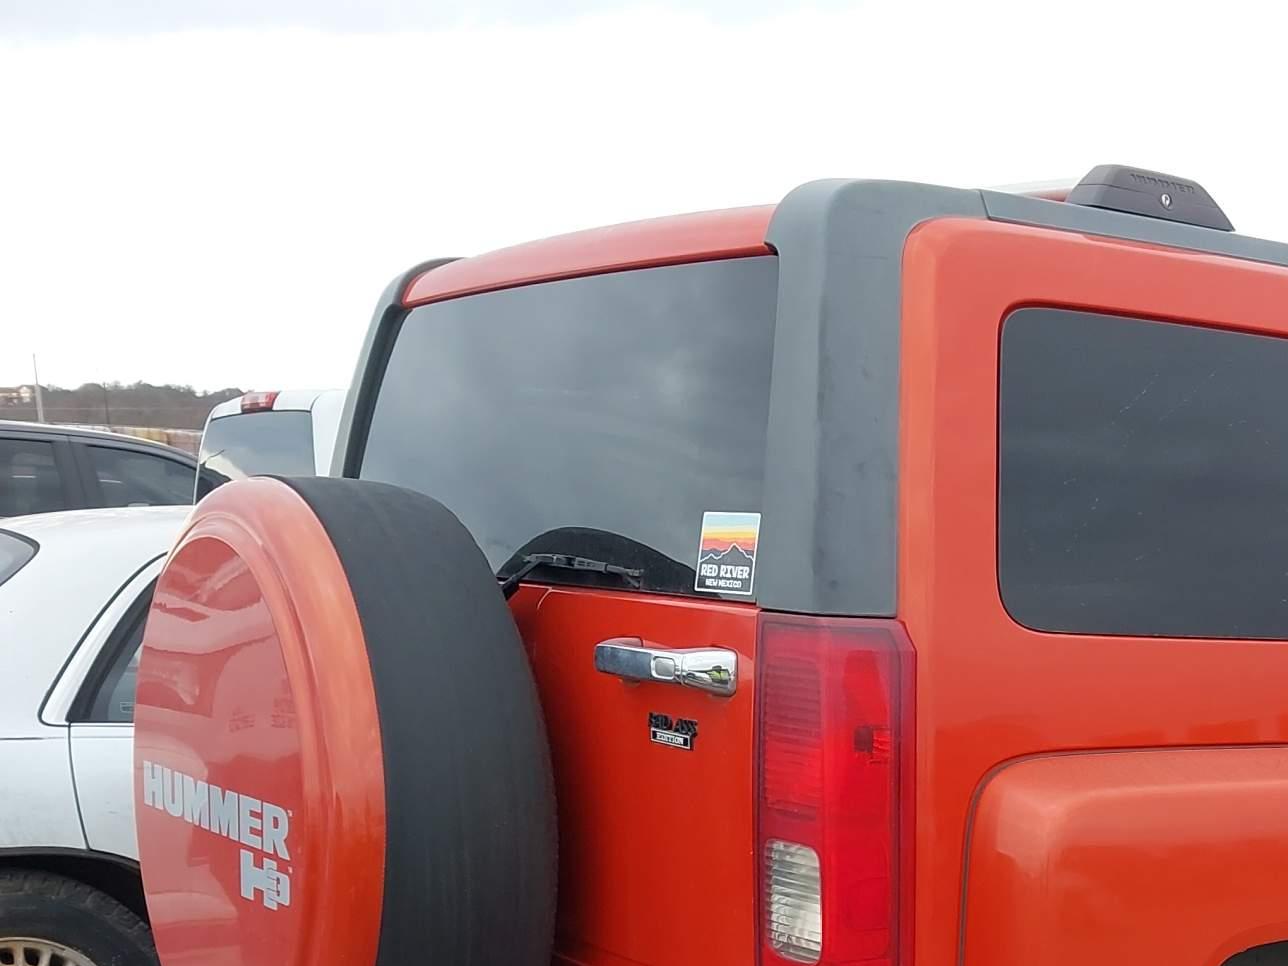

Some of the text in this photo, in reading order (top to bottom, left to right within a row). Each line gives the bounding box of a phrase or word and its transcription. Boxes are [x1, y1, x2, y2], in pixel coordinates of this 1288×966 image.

[701, 563, 750, 579] RED RIVER
[718, 579, 742, 588] MEXICO
[143, 760, 290, 861] HUMMER
